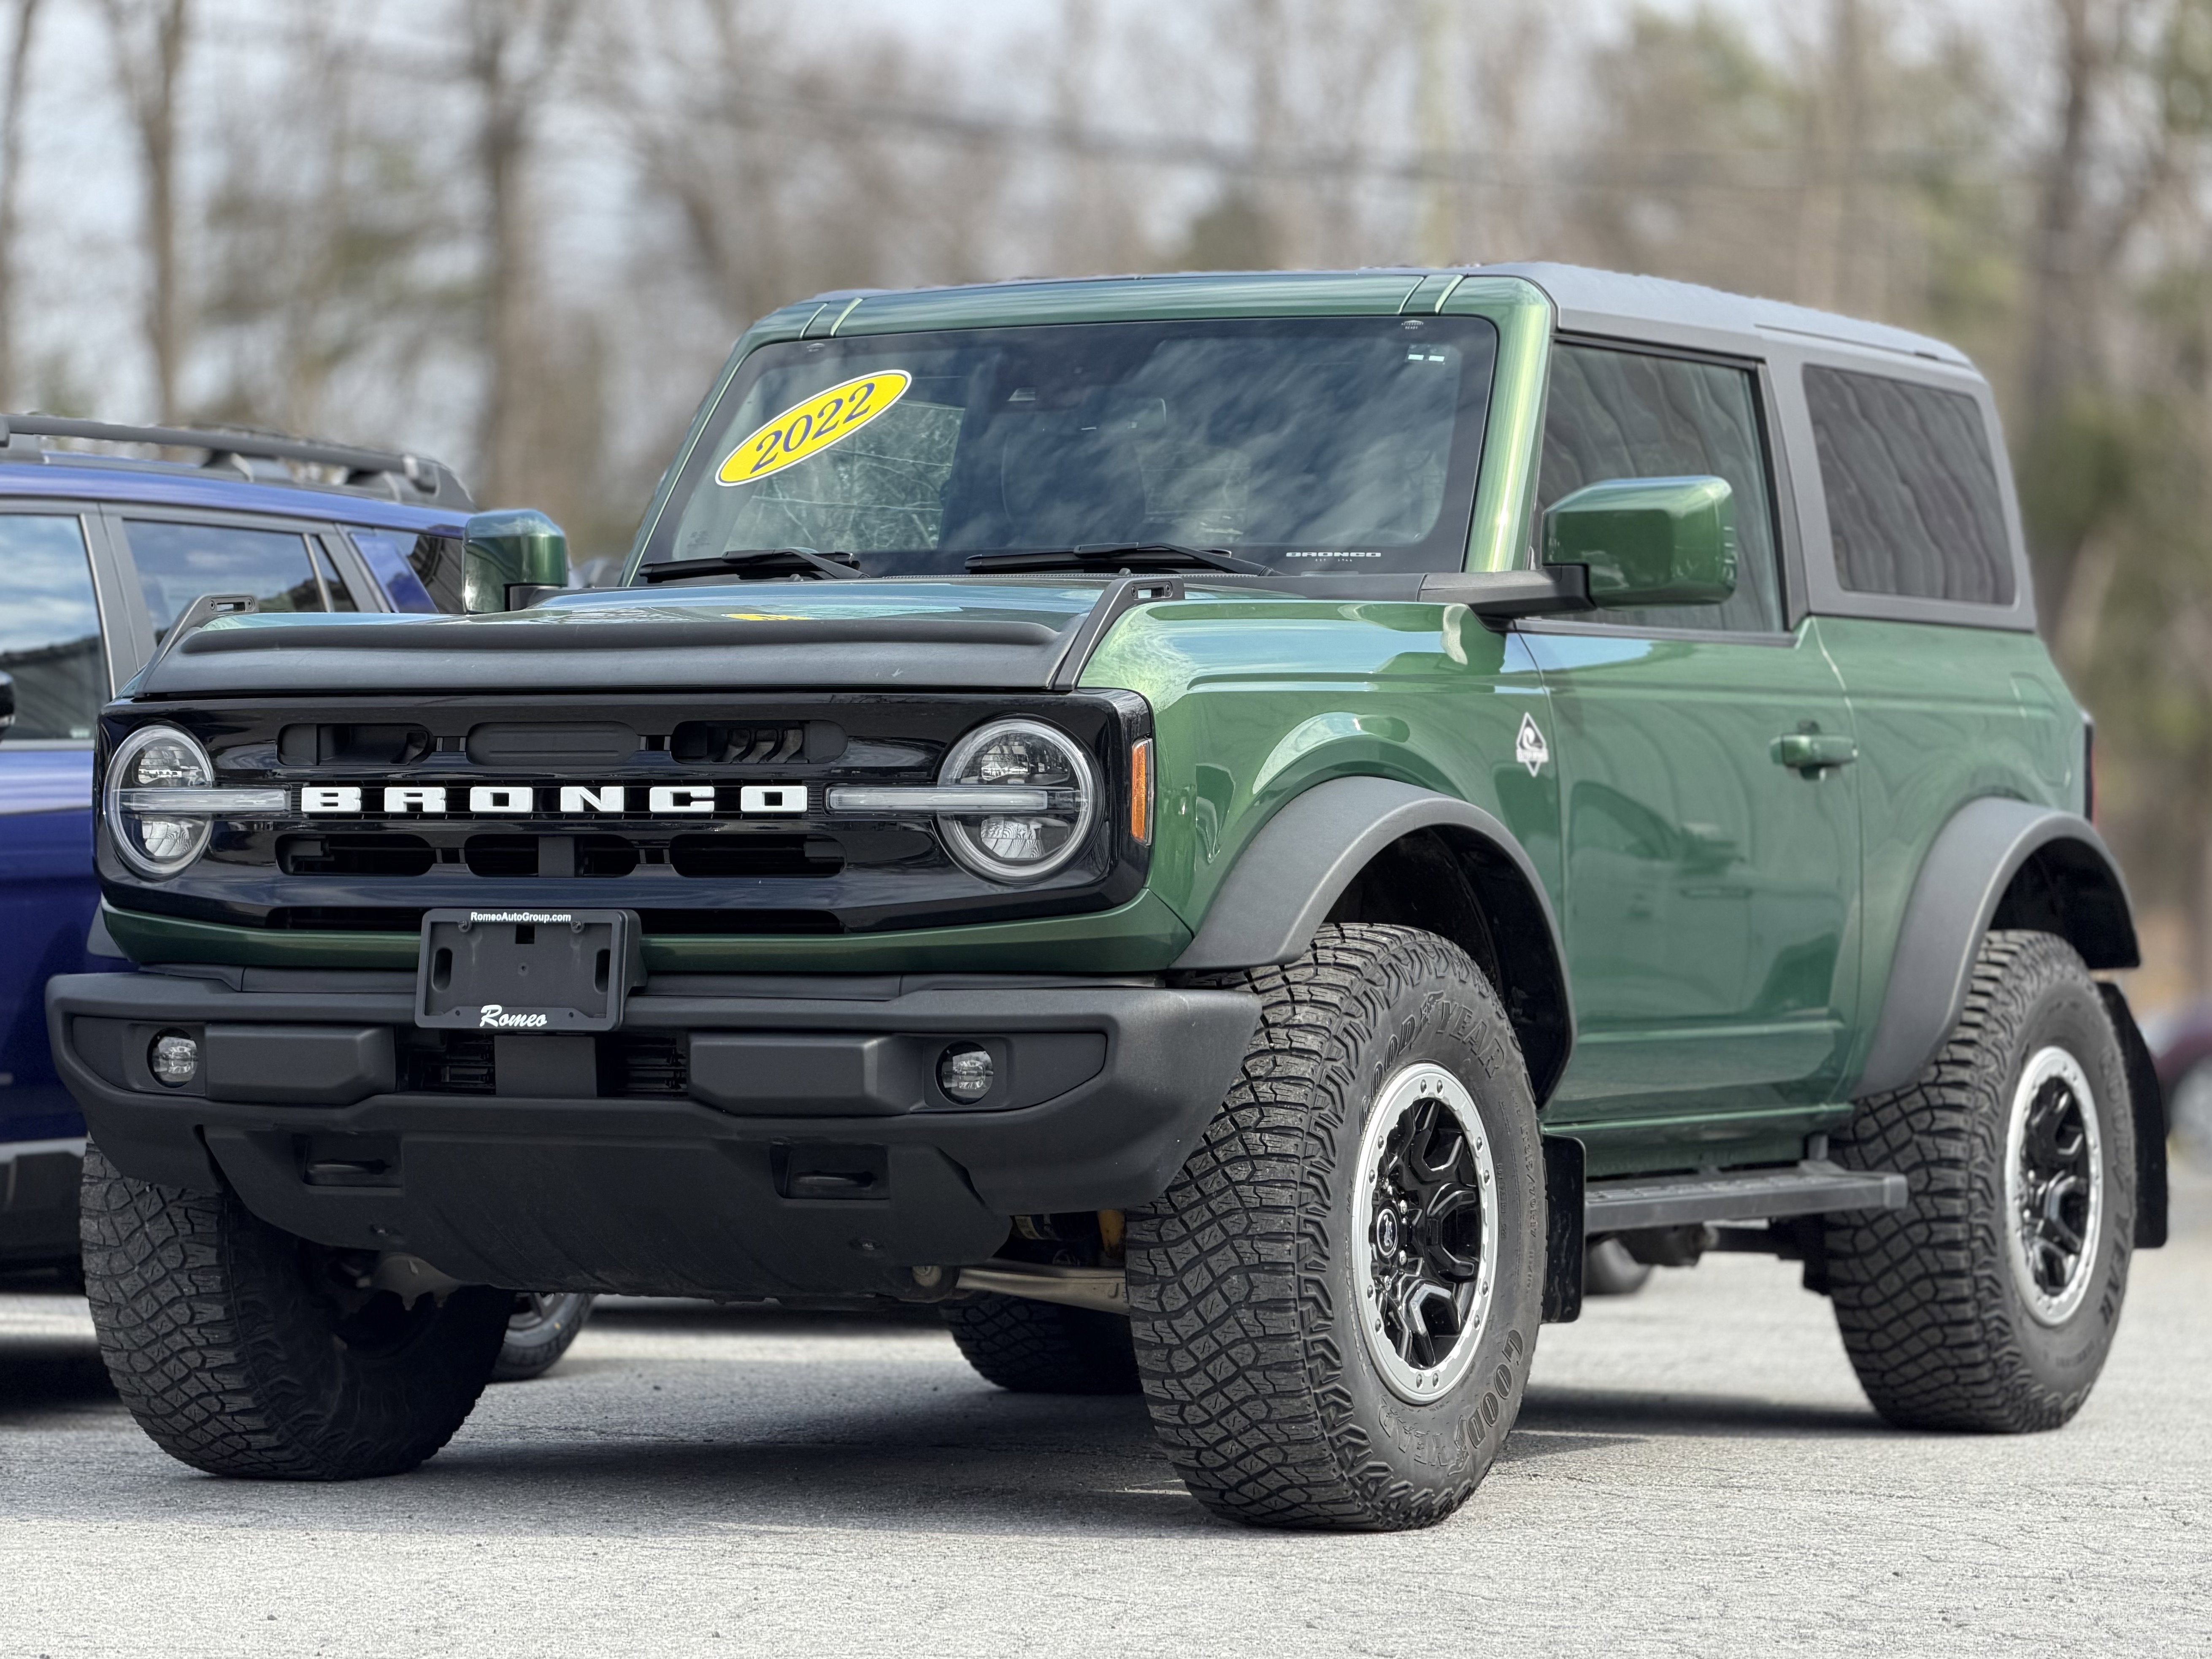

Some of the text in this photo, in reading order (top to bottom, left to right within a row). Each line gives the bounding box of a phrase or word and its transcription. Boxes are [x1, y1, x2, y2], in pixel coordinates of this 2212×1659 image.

[749, 382, 875, 475] 2022
[300, 785, 808, 813] BRONCO
[470, 911, 572, 924] RomeoAutoGroup.com
[479, 1004, 548, 1028] Romeo
[1360, 999, 1505, 1136] GOODYEAR
[1378, 1329, 1524, 1467] GOODYEAR
